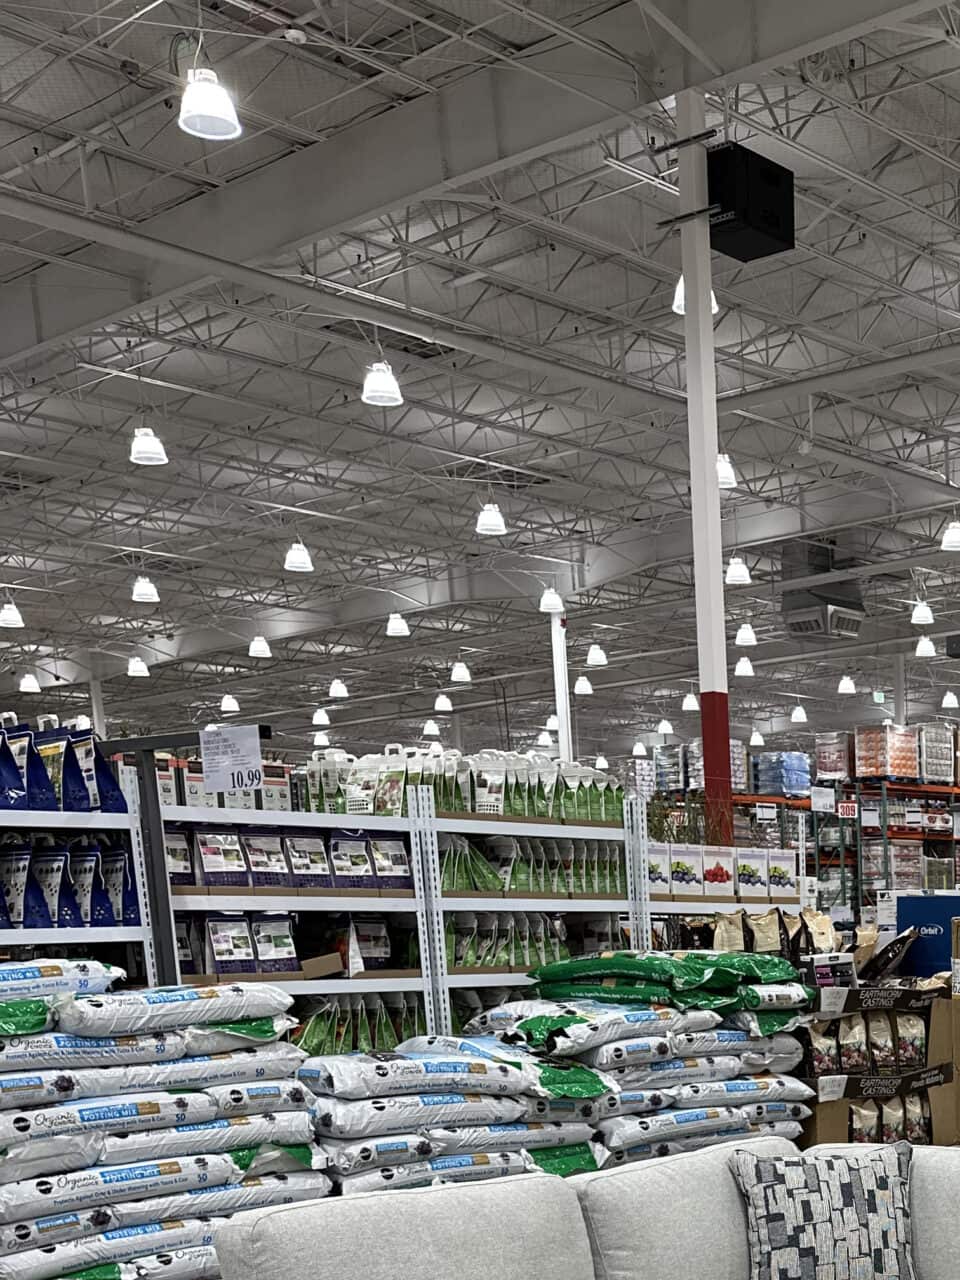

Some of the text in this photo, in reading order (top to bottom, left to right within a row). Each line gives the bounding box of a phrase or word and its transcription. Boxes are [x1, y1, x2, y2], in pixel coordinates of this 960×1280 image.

[231, 769, 261, 788] 10.99
[839, 804, 856, 817] 309
[920, 926, 938, 936] Orbit
[78, 979, 89, 989] 50
[155, 1045, 166, 1054] 50
[255, 1068, 265, 1078] 50
[84, 1108, 138, 1121] POTTING MIX
[175, 1113, 186, 1122] 50
[34, 1112, 77, 1128] Organic
[57, 1174, 99, 1191] Organic
[197, 1173, 208, 1183] 50
[108, 1228, 145, 1239] POTTING
[202, 1236, 212, 1245] 50
